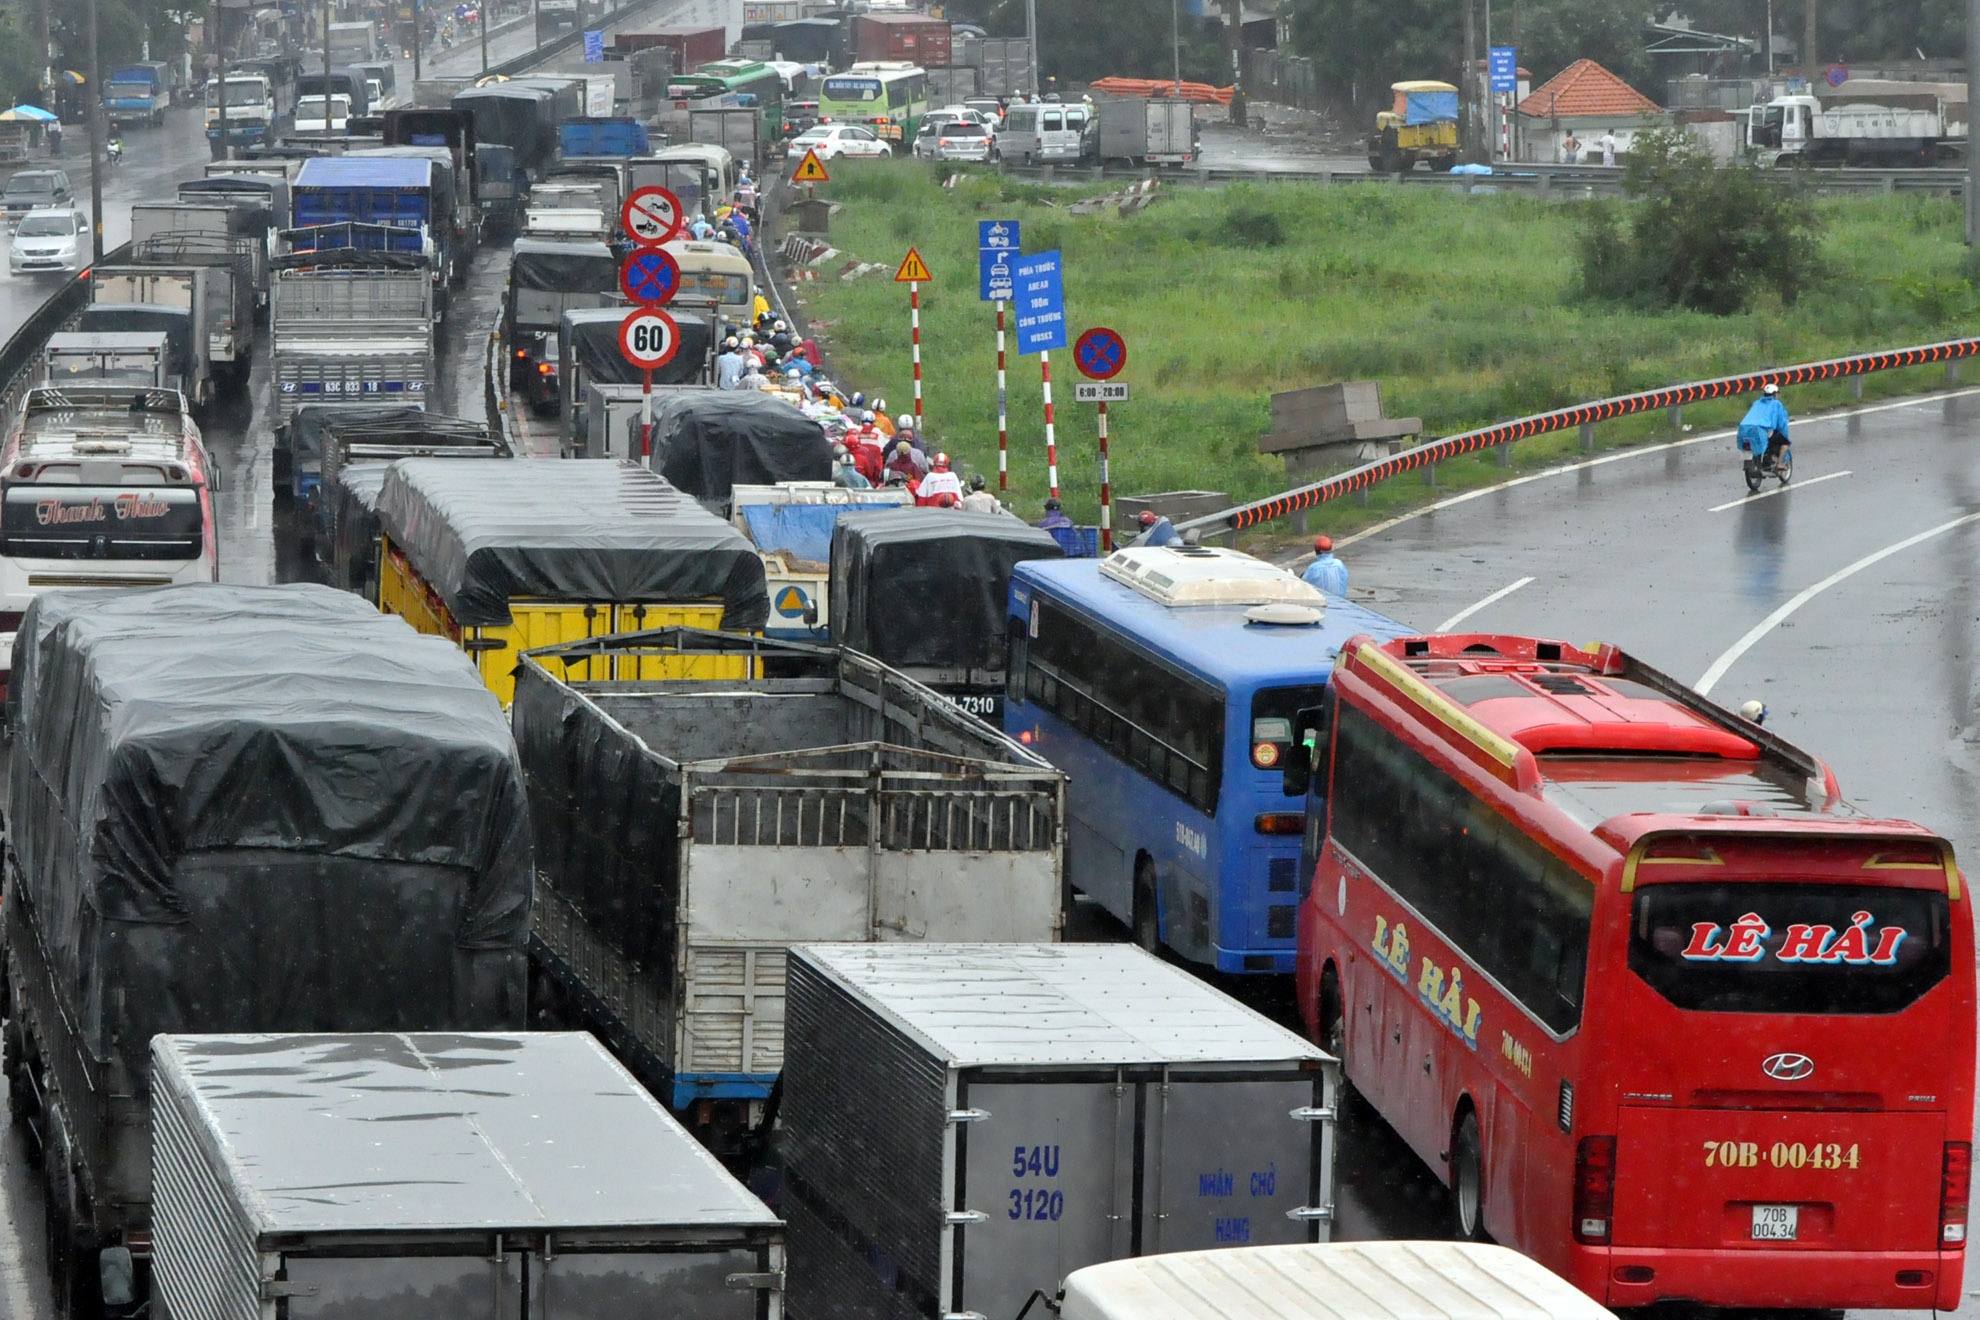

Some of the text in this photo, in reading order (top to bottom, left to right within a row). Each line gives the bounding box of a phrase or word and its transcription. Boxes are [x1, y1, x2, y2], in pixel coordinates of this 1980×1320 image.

[1028, 280, 1049, 292] AHEAD
[634, 325, 663, 352] 60
[325, 382, 341, 392] 63C
[367, 382, 378, 391] 18
[1080, 387, 1097, 397] 6:00
[1103, 386, 1125, 397] 20:00
[1681, 911, 1908, 965] LÊ HẢI
[1372, 915, 1482, 1051] LÊ HẢI
[1013, 1145, 1060, 1178] 54U
[1008, 1188, 1064, 1221] 3120
[1763, 1208, 1787, 1222] 70B
[1753, 1224, 1795, 1238] 004.34
